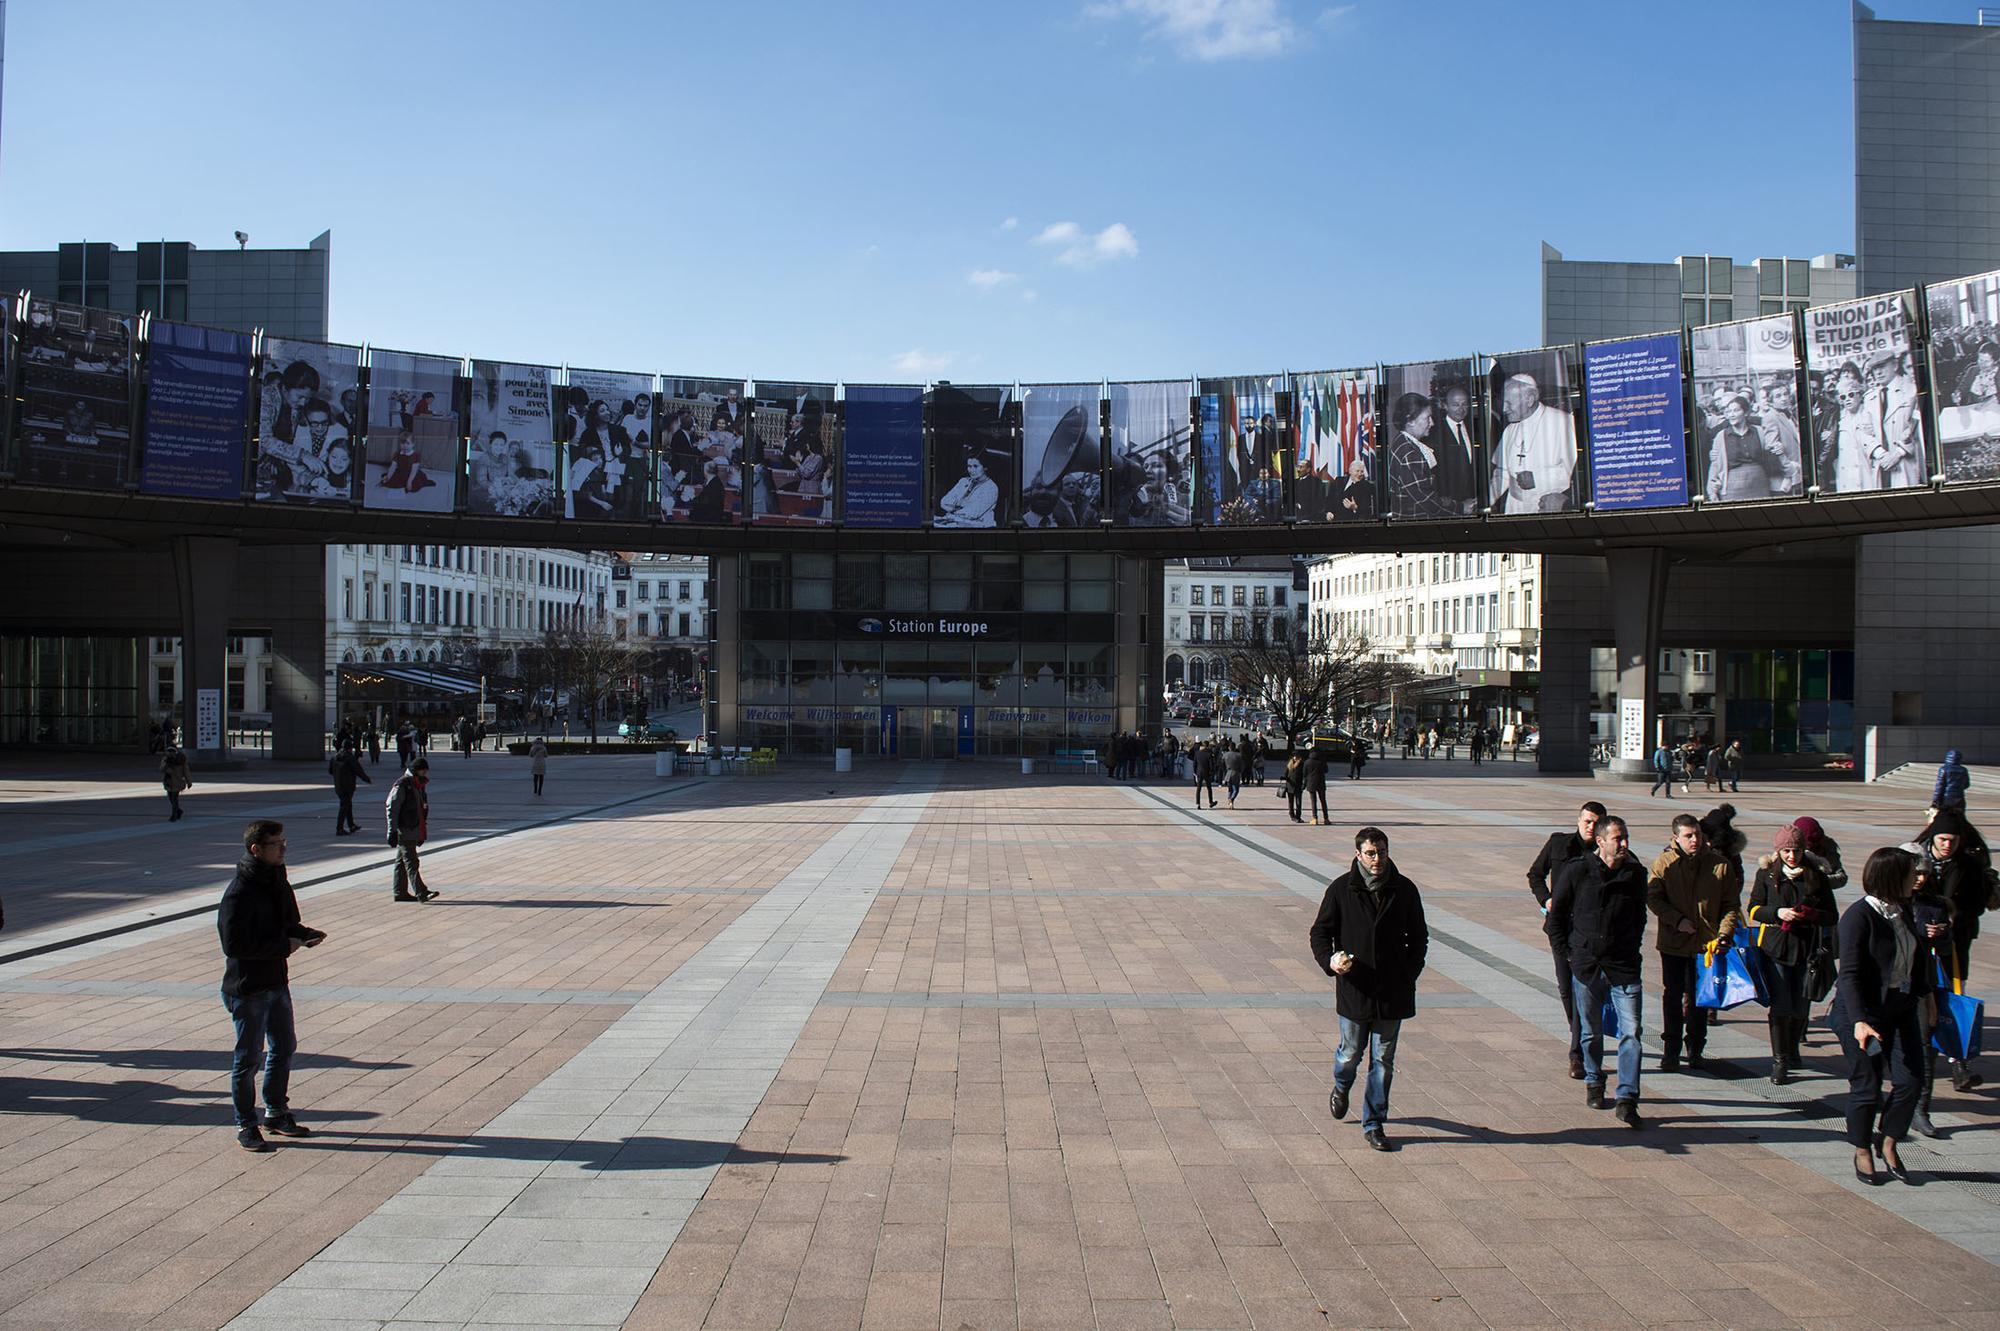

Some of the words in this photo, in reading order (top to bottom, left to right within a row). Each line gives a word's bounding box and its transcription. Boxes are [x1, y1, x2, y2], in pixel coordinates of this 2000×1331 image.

[1814, 305, 1868, 327] UNION
[1817, 341, 1862, 358] JUIFS
[1866, 336, 1886, 352] de
[505, 379, 529, 388] pour
[512, 389, 524, 397] en
[526, 400, 549, 408] avec
[508, 405, 544, 418] Simone
[889, 619, 934, 633] Station
[940, 619, 988, 637] Europe
[746, 708, 796, 721] Welcome
[807, 708, 876, 721] Willkommen
[988, 711, 1046, 722] Bienvenue
[1067, 711, 1111, 723] Welkom
